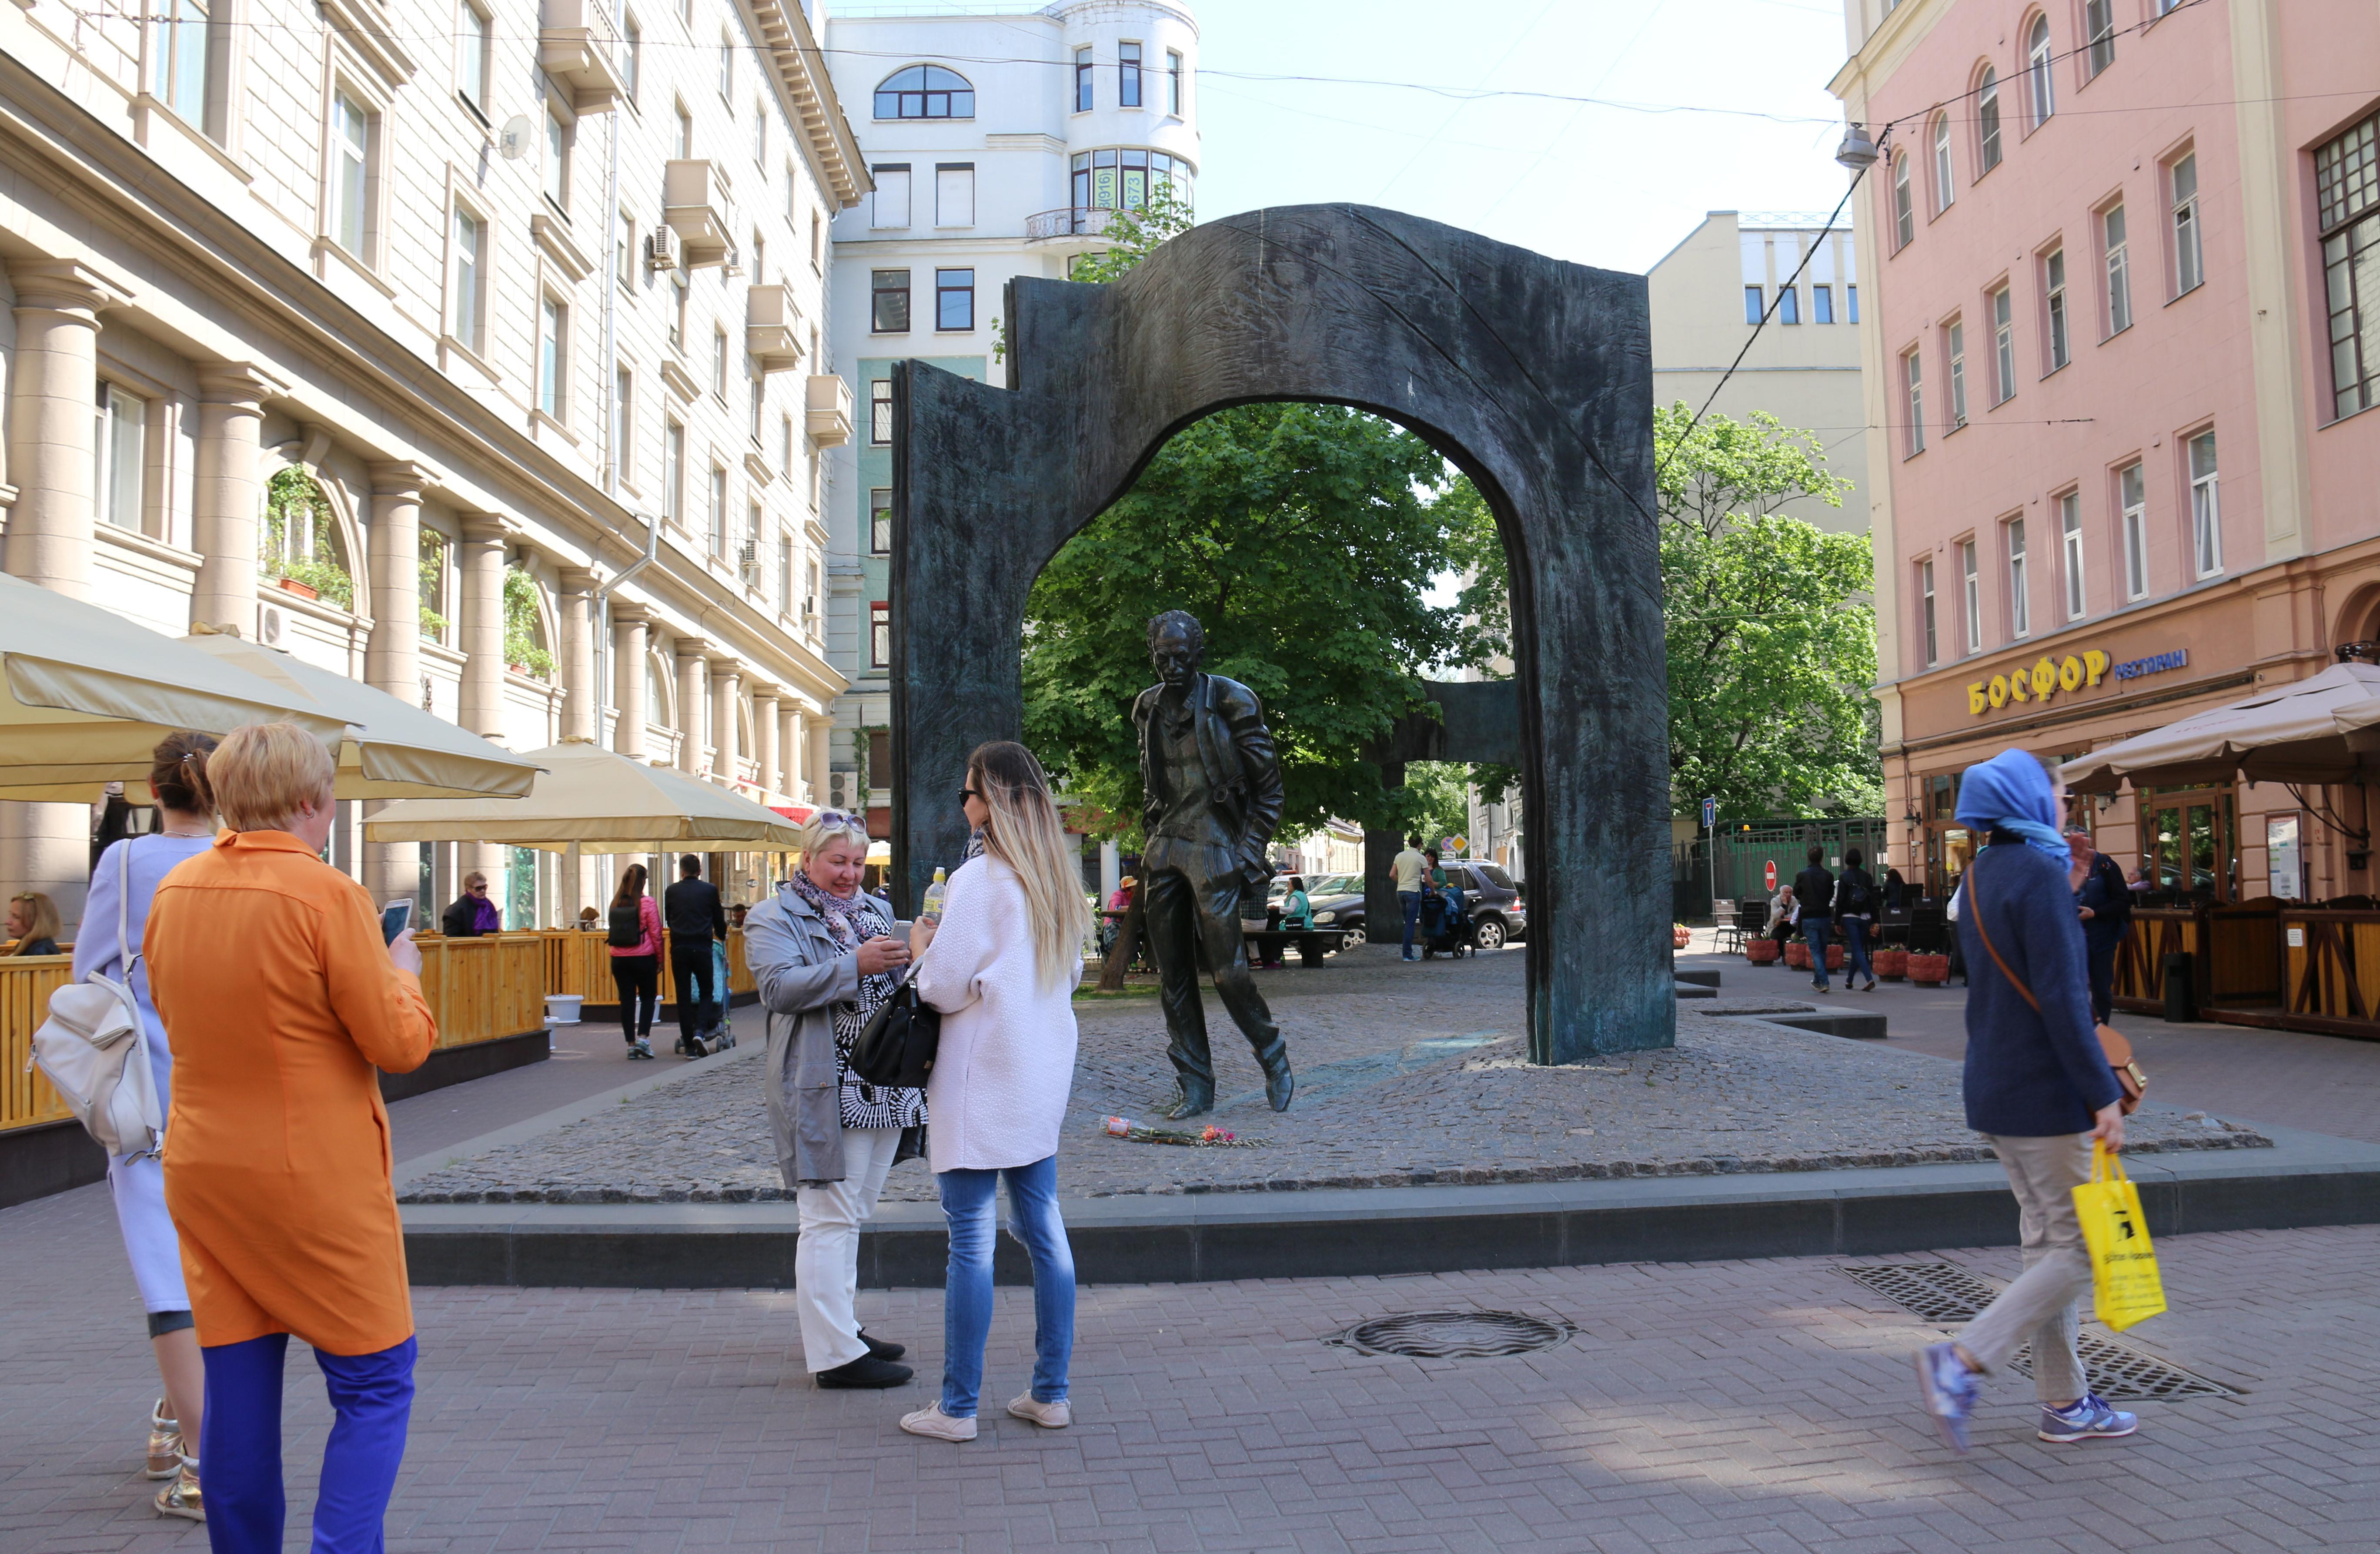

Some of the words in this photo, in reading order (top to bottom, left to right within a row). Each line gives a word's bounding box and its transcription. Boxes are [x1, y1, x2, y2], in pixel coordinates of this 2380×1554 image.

[1127, 177, 1140, 204] 673
[1967, 650, 2109, 714] БОСФОР
[2115, 649, 2186, 680] РЕСТОРАН
